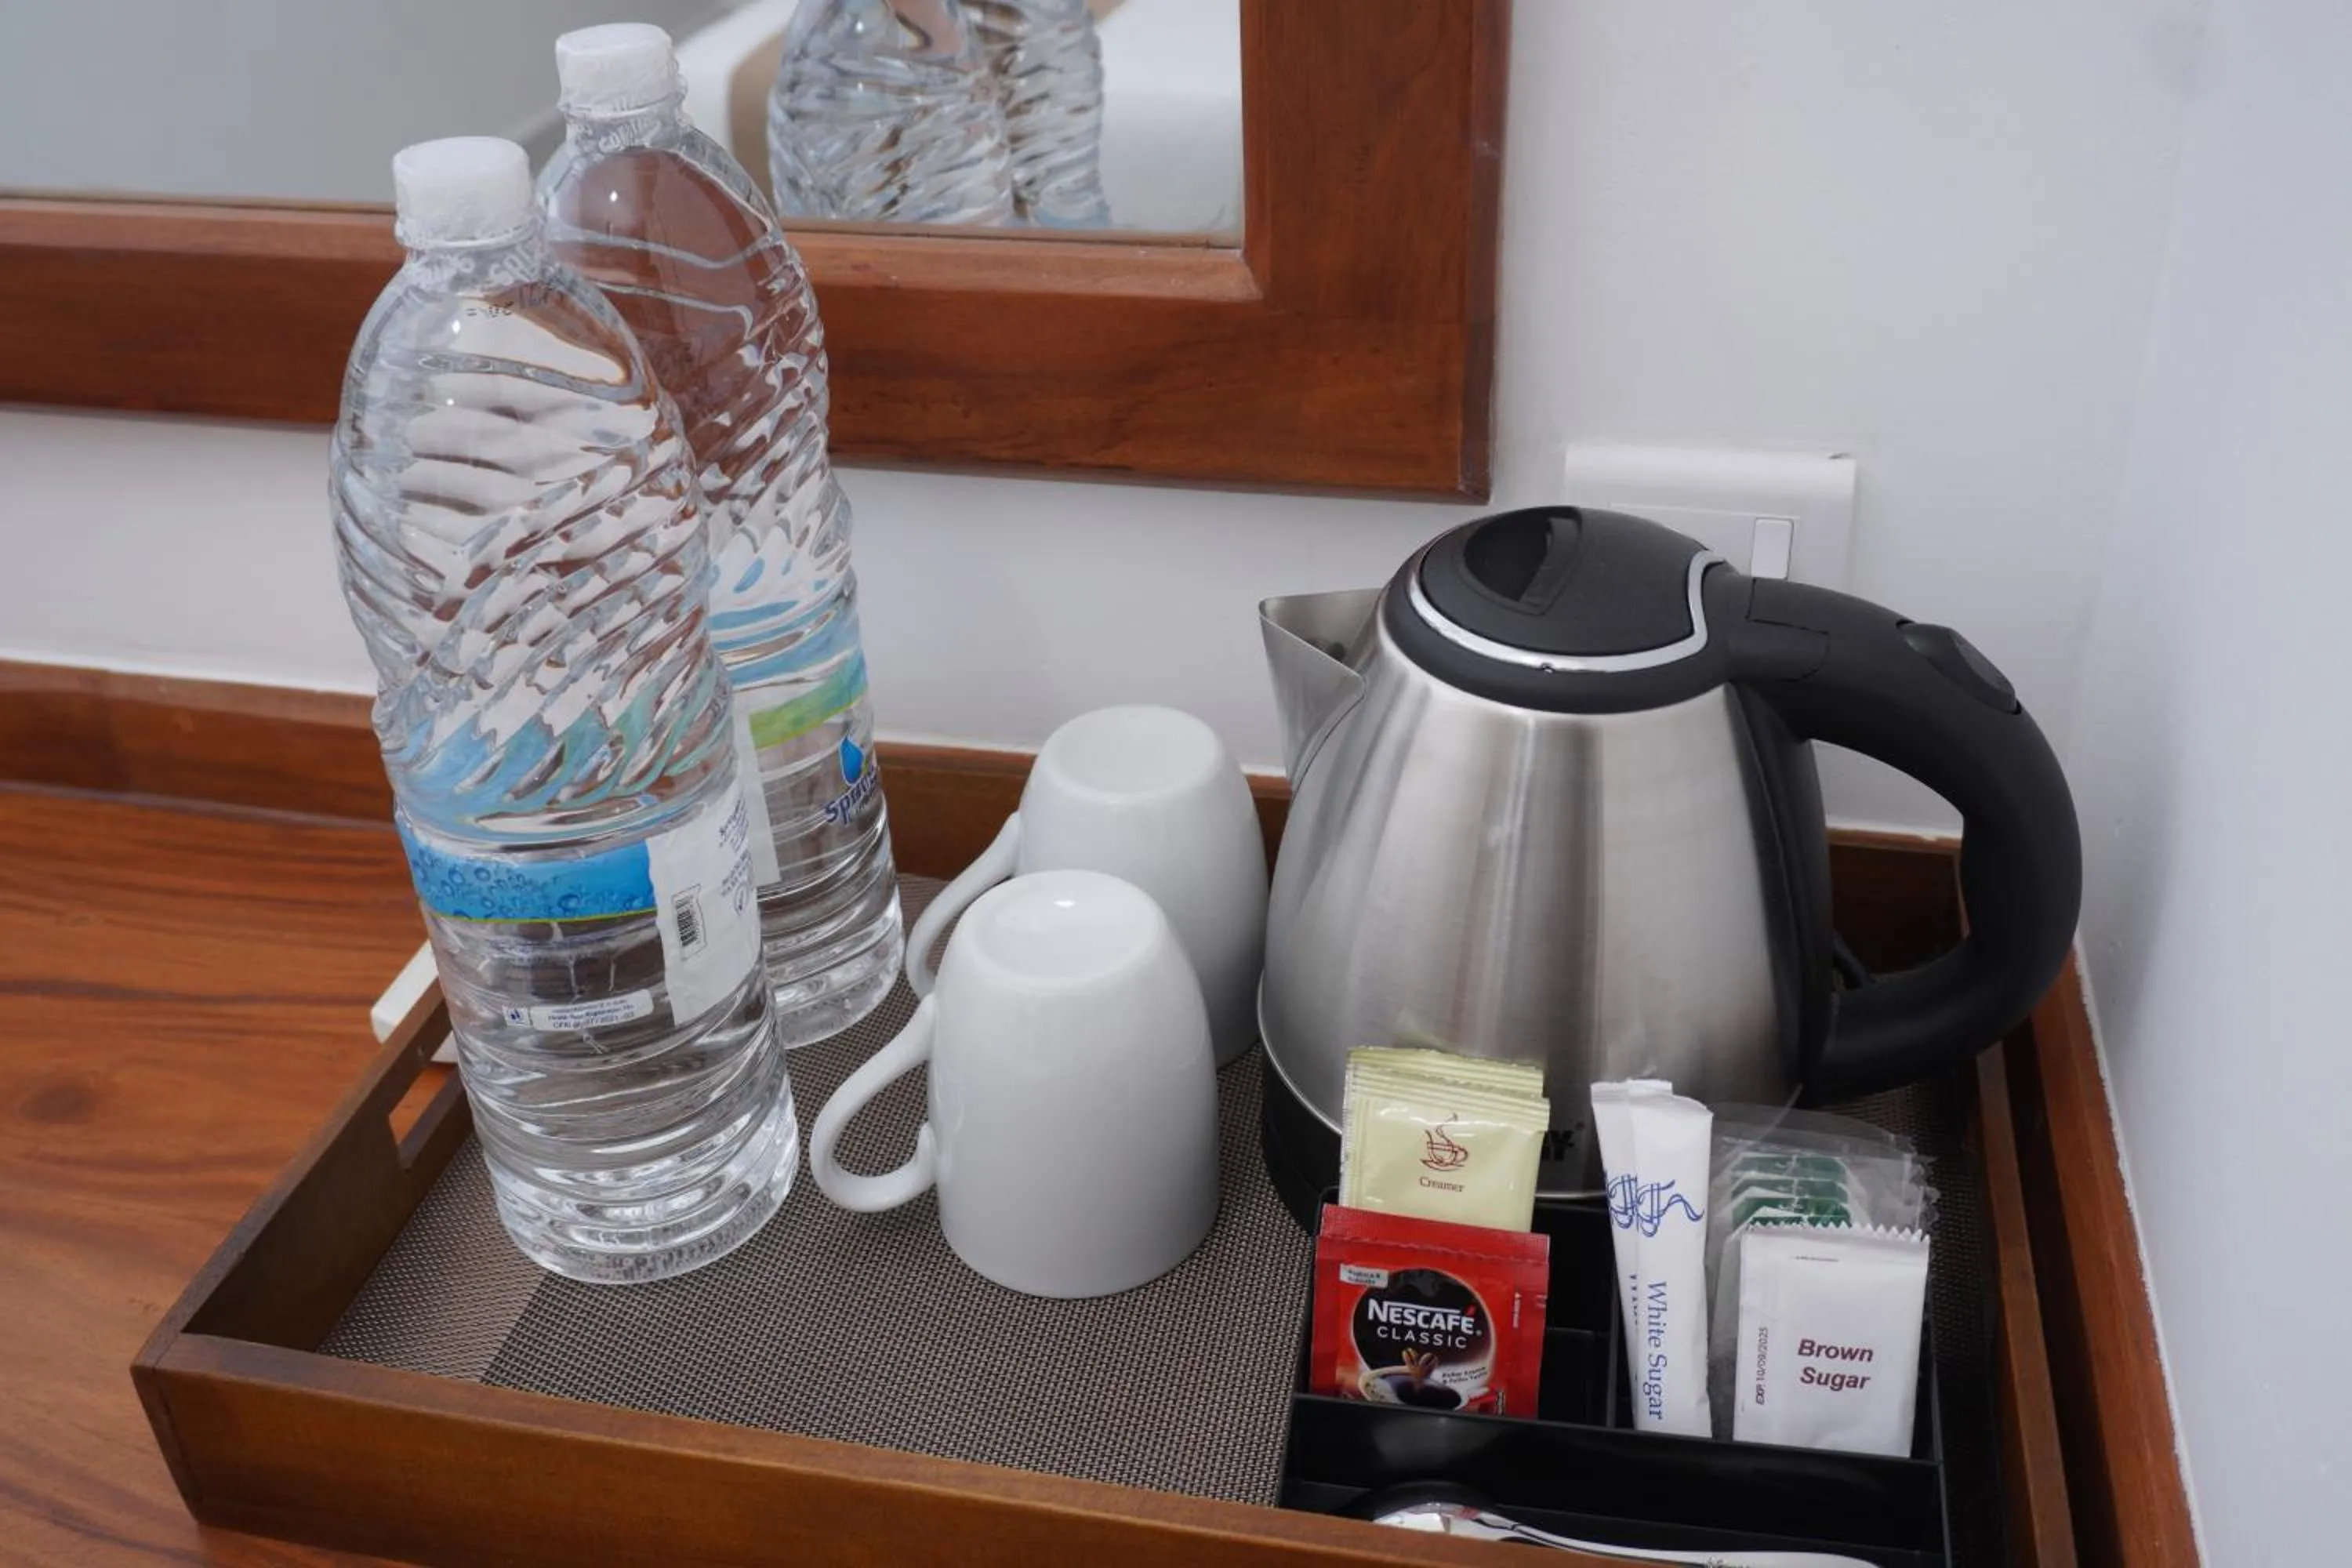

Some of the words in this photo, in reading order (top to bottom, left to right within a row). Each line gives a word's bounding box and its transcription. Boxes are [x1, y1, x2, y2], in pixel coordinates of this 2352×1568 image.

[1419, 1176, 1465, 1192] Creamer
[1367, 1298, 1475, 1336] NESCAFÉ
[1647, 1281, 1668, 1349] White
[1376, 1326, 1468, 1349] CLASSIC
[1797, 1338, 1875, 1363] Brown
[1642, 1353, 1668, 1420] Sugar
[1799, 1366, 1871, 1392] Sugar
